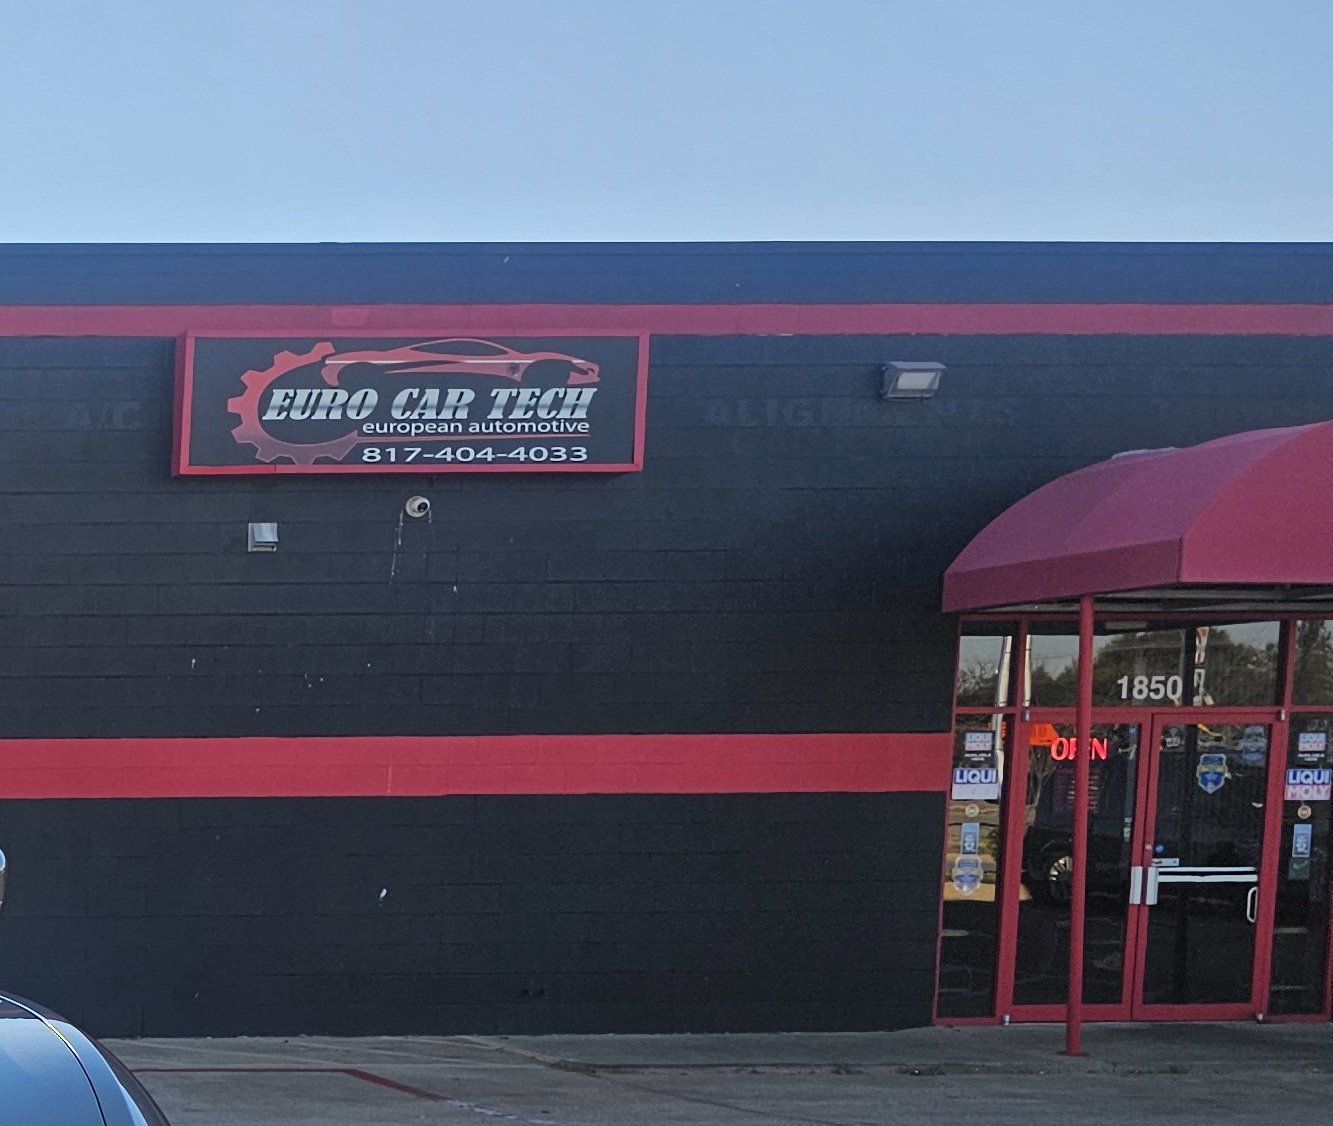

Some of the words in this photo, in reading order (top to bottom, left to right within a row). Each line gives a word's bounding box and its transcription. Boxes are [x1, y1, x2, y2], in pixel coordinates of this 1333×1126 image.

[261, 388, 379, 420] EURO
[391, 388, 475, 420] CAR
[486, 387, 597, 420] TECH
[362, 420, 462, 436] european
[468, 418, 590, 434] automotive
[362, 446, 588, 463] 817-404-4033
[1116, 675, 1183, 700] 1850
[1050, 737, 1107, 761] OPN
[955, 769, 998, 784] LIQUI
[1288, 770, 1330, 785] LIQUI
[1286, 785, 1330, 800] MOLY
